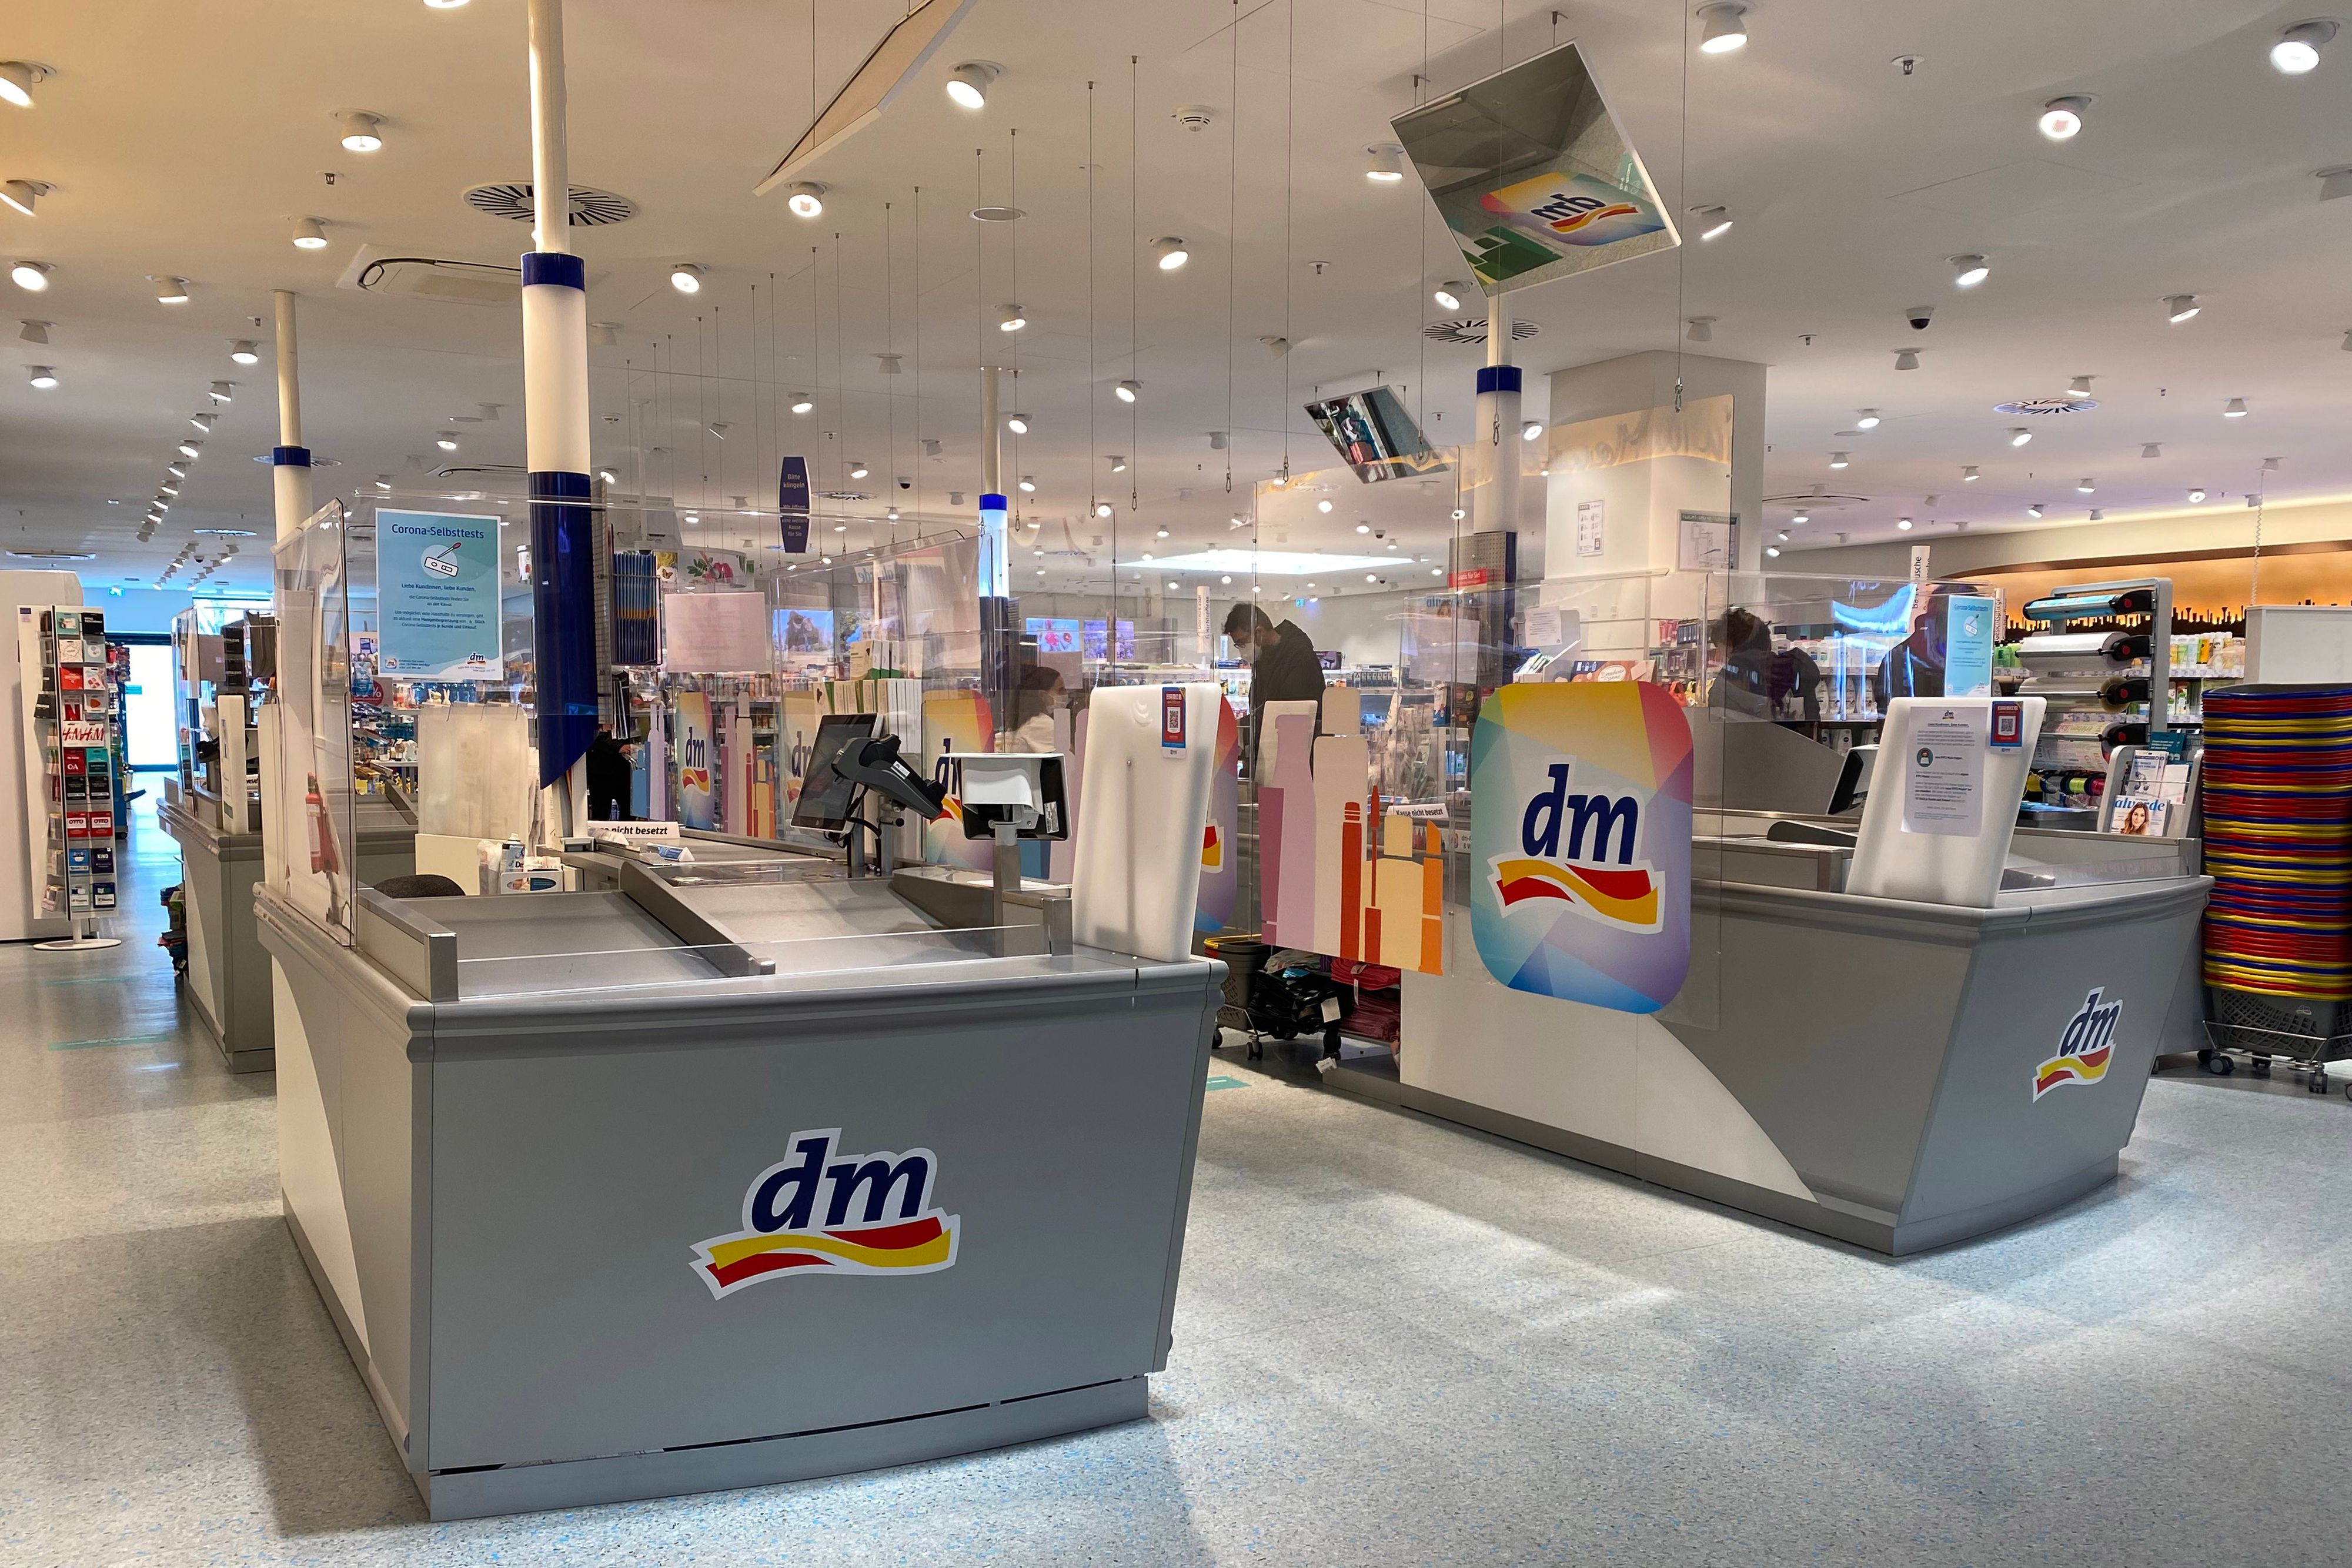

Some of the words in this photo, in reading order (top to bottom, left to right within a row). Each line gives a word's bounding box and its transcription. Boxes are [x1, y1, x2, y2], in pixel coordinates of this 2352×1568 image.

[392, 524, 485, 539] Corona-Selbsttests
[1913, 556, 1922, 579] usche
[470, 652, 484, 661] dm
[685, 726, 705, 768] dm
[1522, 763, 1639, 865] dm
[636, 826, 668, 835] besetzt
[2059, 992, 2120, 1058] dm
[751, 1136, 928, 1233] dm
